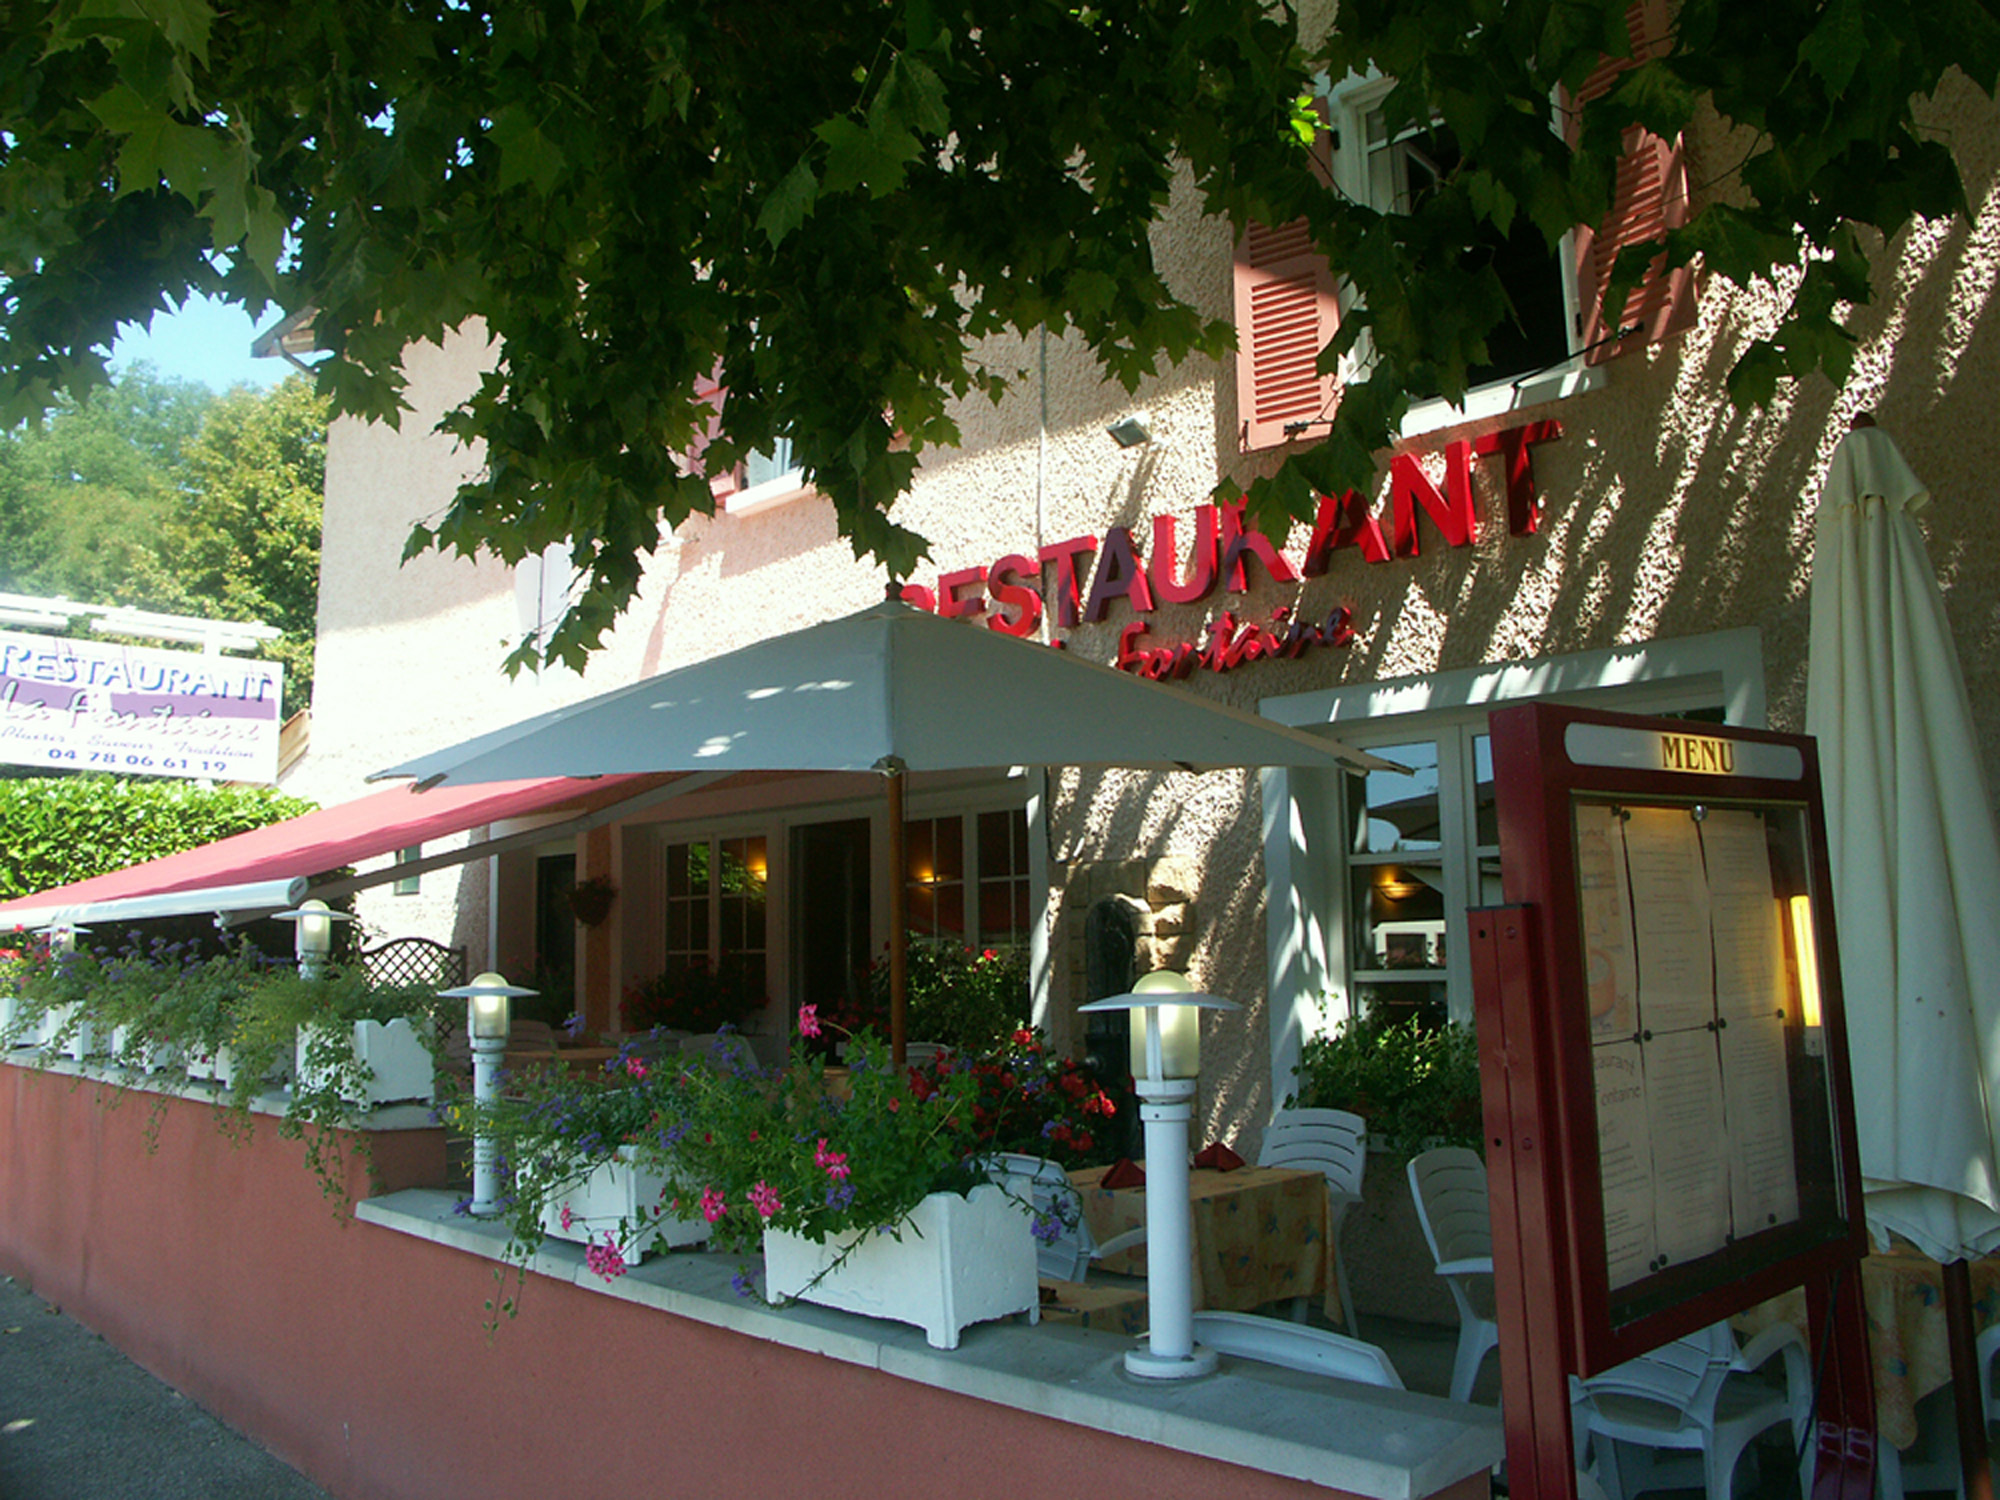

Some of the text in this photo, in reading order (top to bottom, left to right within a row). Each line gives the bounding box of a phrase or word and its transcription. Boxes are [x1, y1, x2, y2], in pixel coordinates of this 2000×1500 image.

[0, 644, 273, 702] RESTAURANT
[48, 748, 227, 773] 04 78 06 61 19
[1661, 736, 1734, 772] MENU
